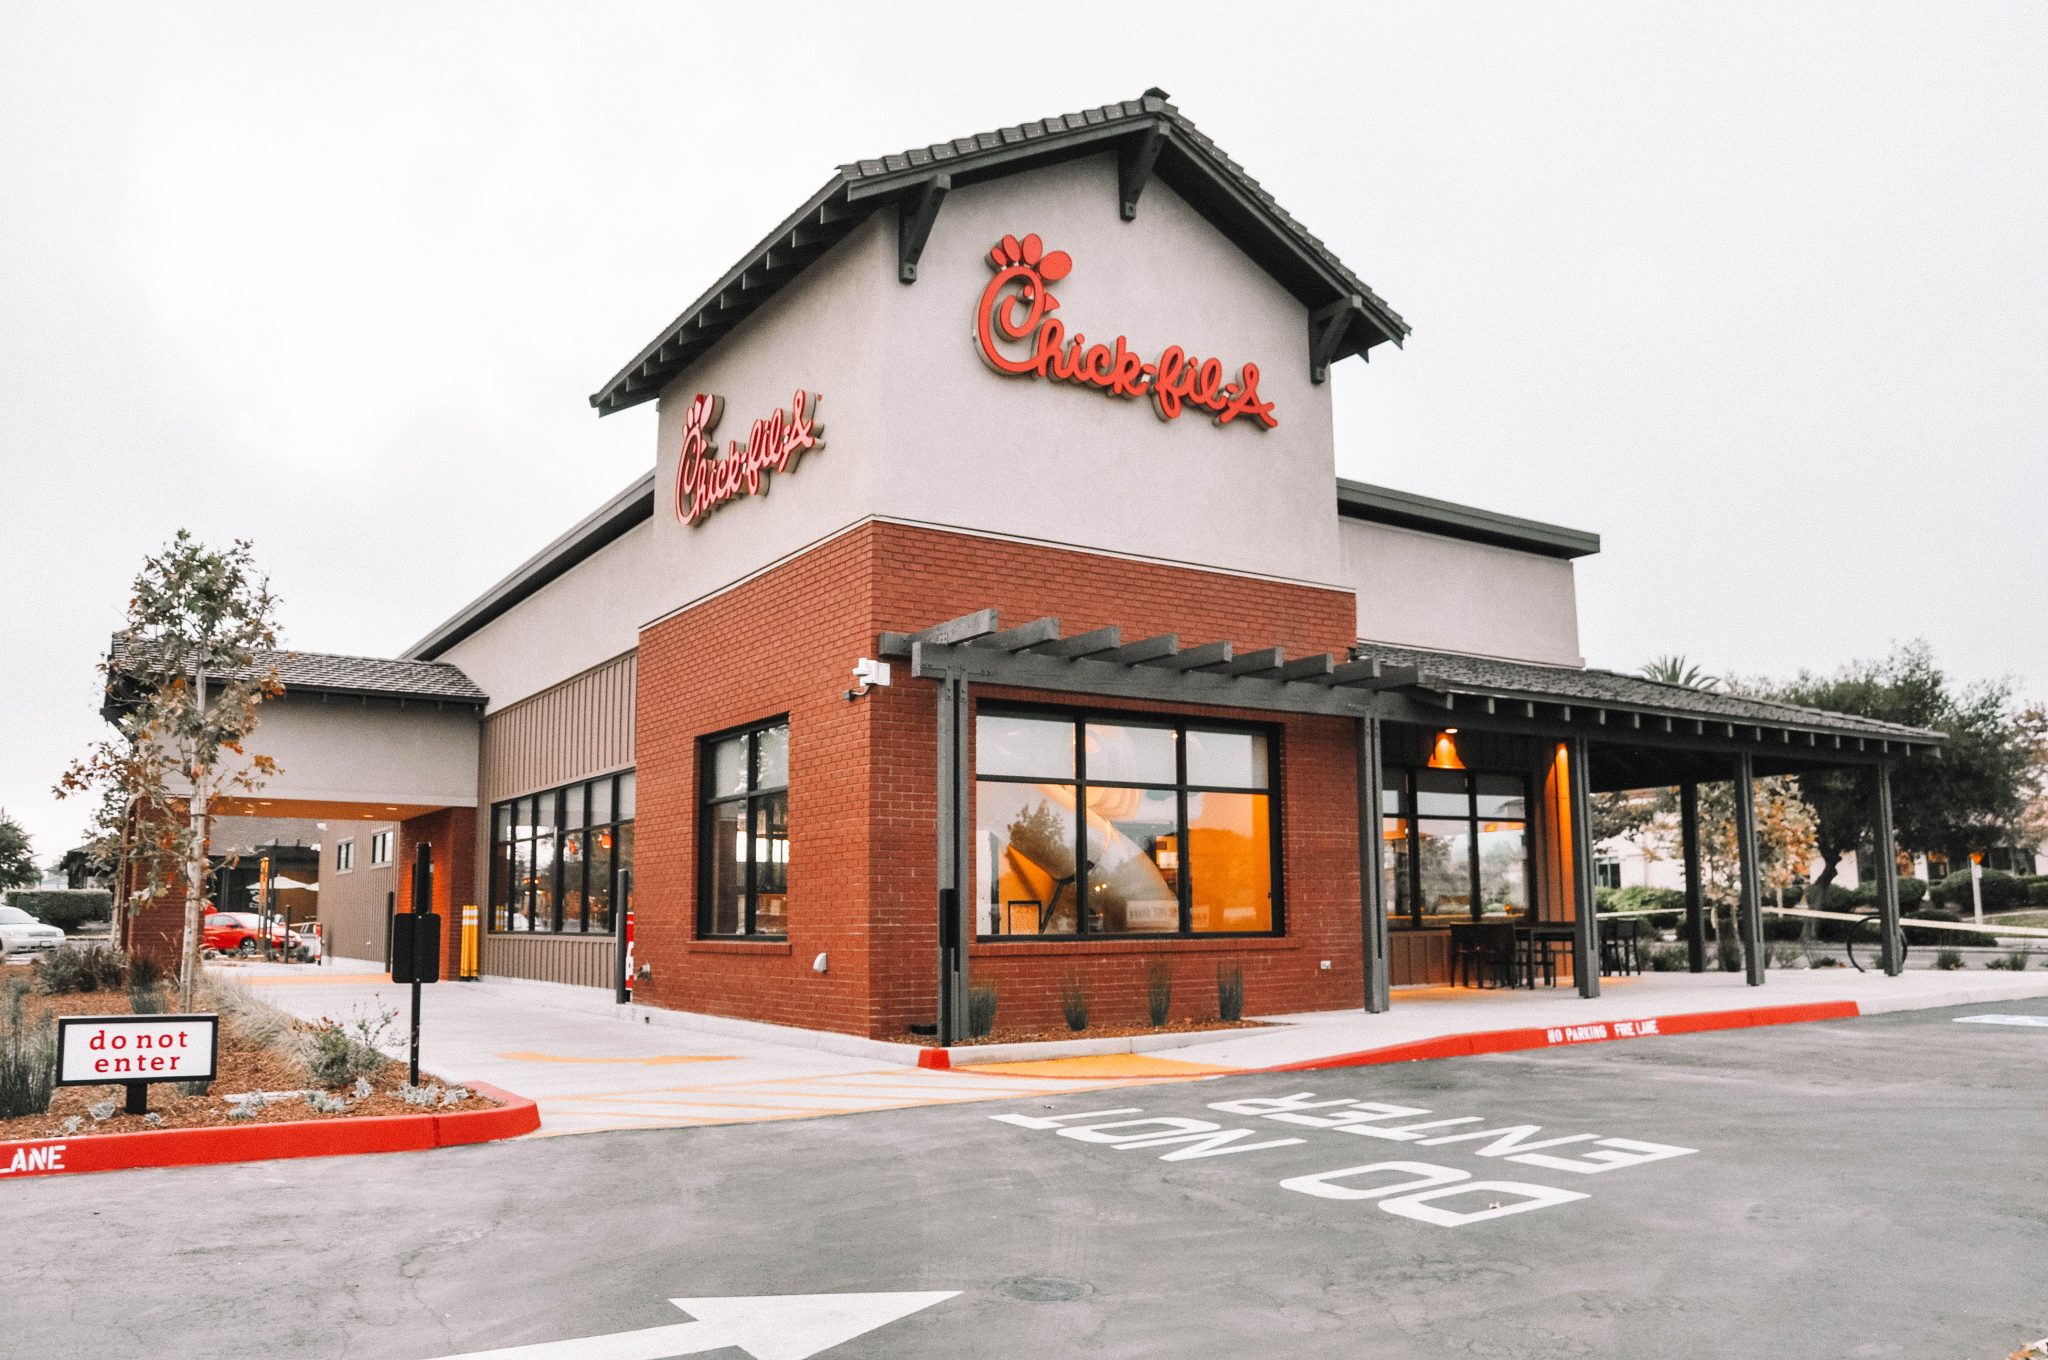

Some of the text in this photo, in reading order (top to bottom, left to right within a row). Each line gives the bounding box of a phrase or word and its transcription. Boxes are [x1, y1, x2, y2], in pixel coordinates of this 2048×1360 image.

[977, 233, 1278, 428] Chick-fil-A
[676, 389, 816, 525] Chick-fil-A
[90, 1030, 188, 1050] do not
[95, 1054, 181, 1073] enter
[1547, 1019, 1660, 1044] NO PARKING FIRE LANE
[988, 1108, 1592, 1228] DO NOT
[1206, 1092, 1699, 1175] ENTER
